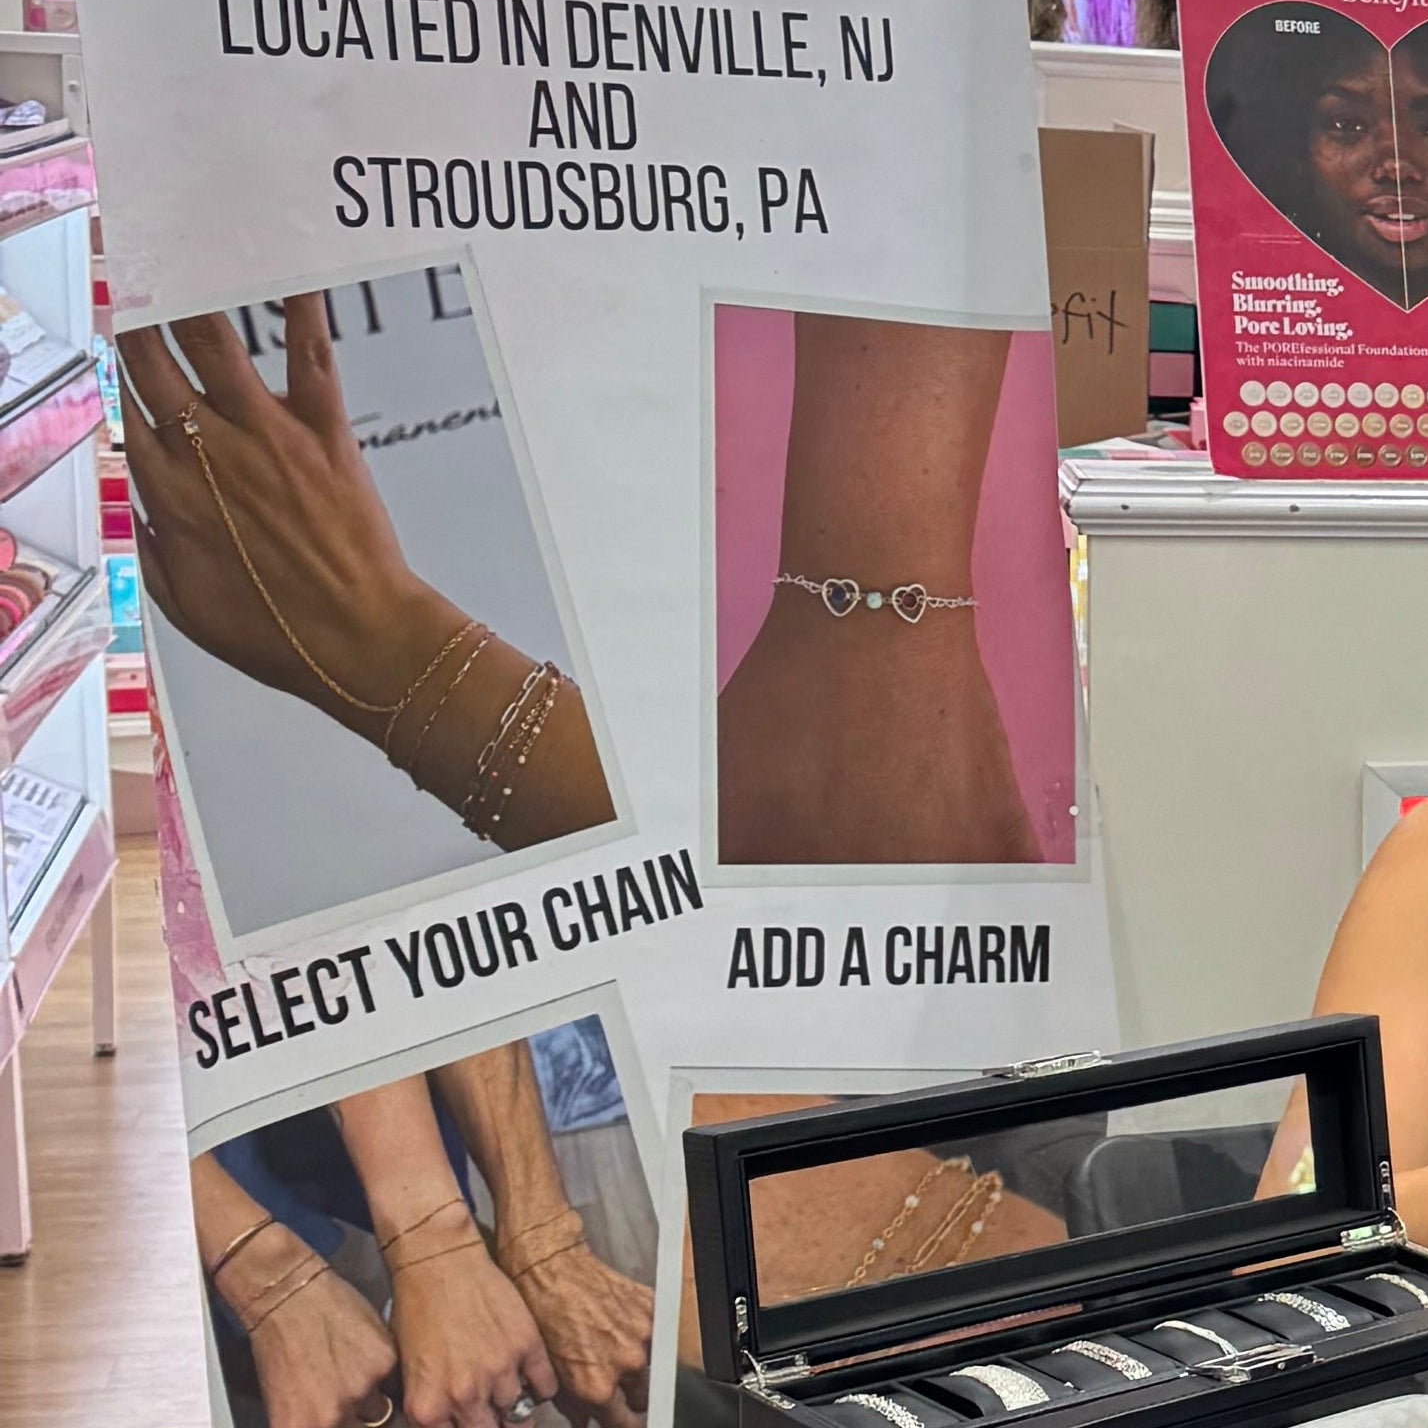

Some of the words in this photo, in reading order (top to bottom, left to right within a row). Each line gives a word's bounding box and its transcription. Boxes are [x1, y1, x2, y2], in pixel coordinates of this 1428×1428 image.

[566, 0, 828, 88] DENVILLE,
[842, 14, 894, 83] NJ
[1275, 20, 1320, 34] BEFORE
[530, 80, 639, 153] AND
[334, 156, 746, 240] STROUDSBURG,
[760, 168, 829, 233] PA
[1231, 270, 1345, 296] Smoothing.
[1233, 293, 1322, 318] Blurring.
[1051, 290, 1129, 355] fit
[1234, 316, 1281, 334] Pore
[1283, 317, 1354, 341] Loving.
[1236, 341, 1260, 353] The
[1358, 344, 1428, 357] Foundation
[1236, 356, 1264, 367] with
[1267, 357, 1345, 368] niacinamide
[187, 944, 377, 1070] SELECT
[384, 901, 539, 1001] YOUR
[545, 848, 704, 952] CHAIN
[727, 926, 821, 989] ADD
[838, 926, 871, 987] A
[884, 924, 1052, 985] CHARM
